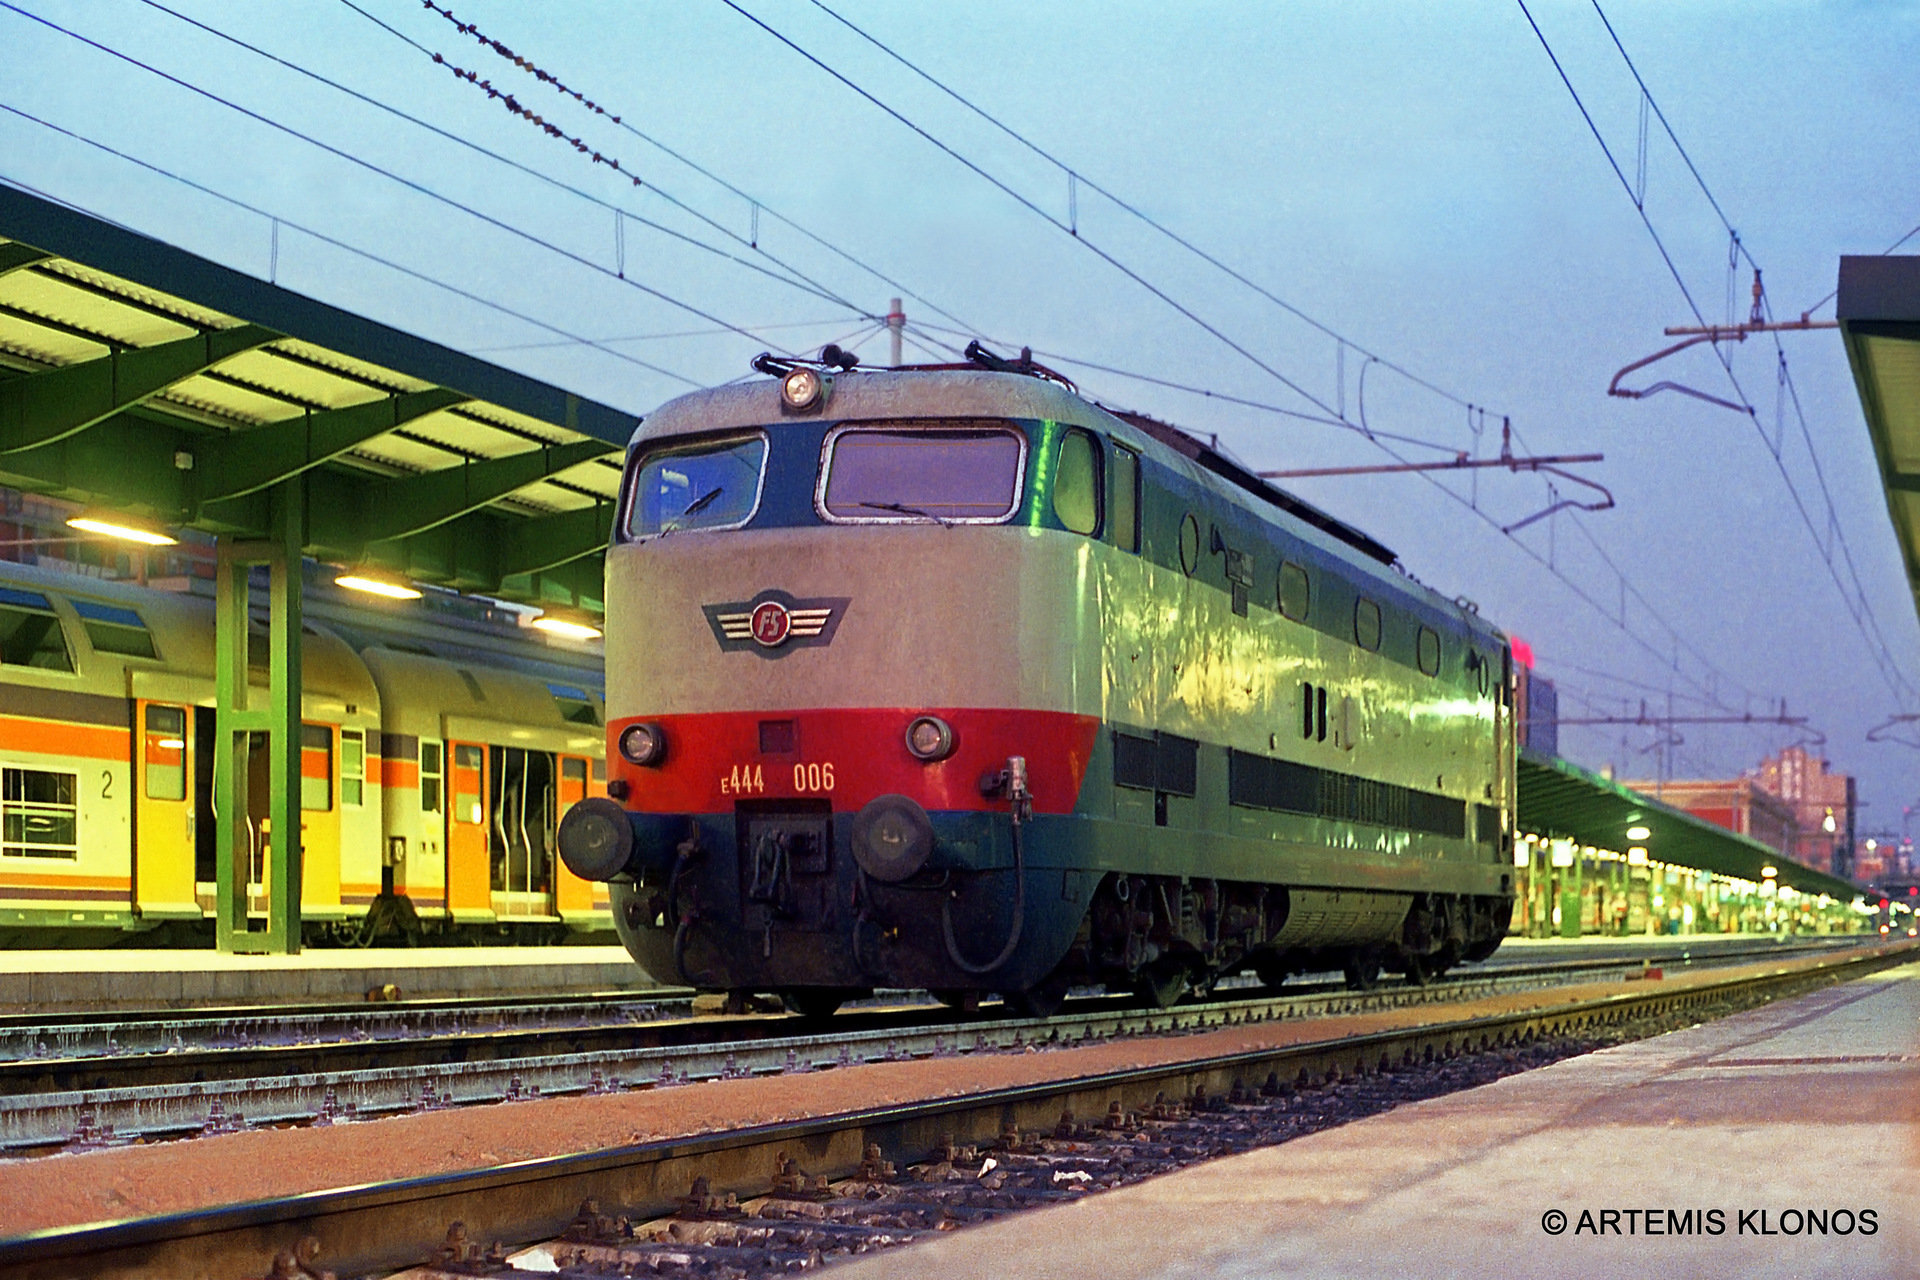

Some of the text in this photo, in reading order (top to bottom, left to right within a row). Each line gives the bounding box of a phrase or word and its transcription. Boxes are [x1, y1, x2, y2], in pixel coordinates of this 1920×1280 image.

[758, 610, 782, 637] FS
[102, 770, 112, 799] 2
[721, 762, 835, 794] E444 006
